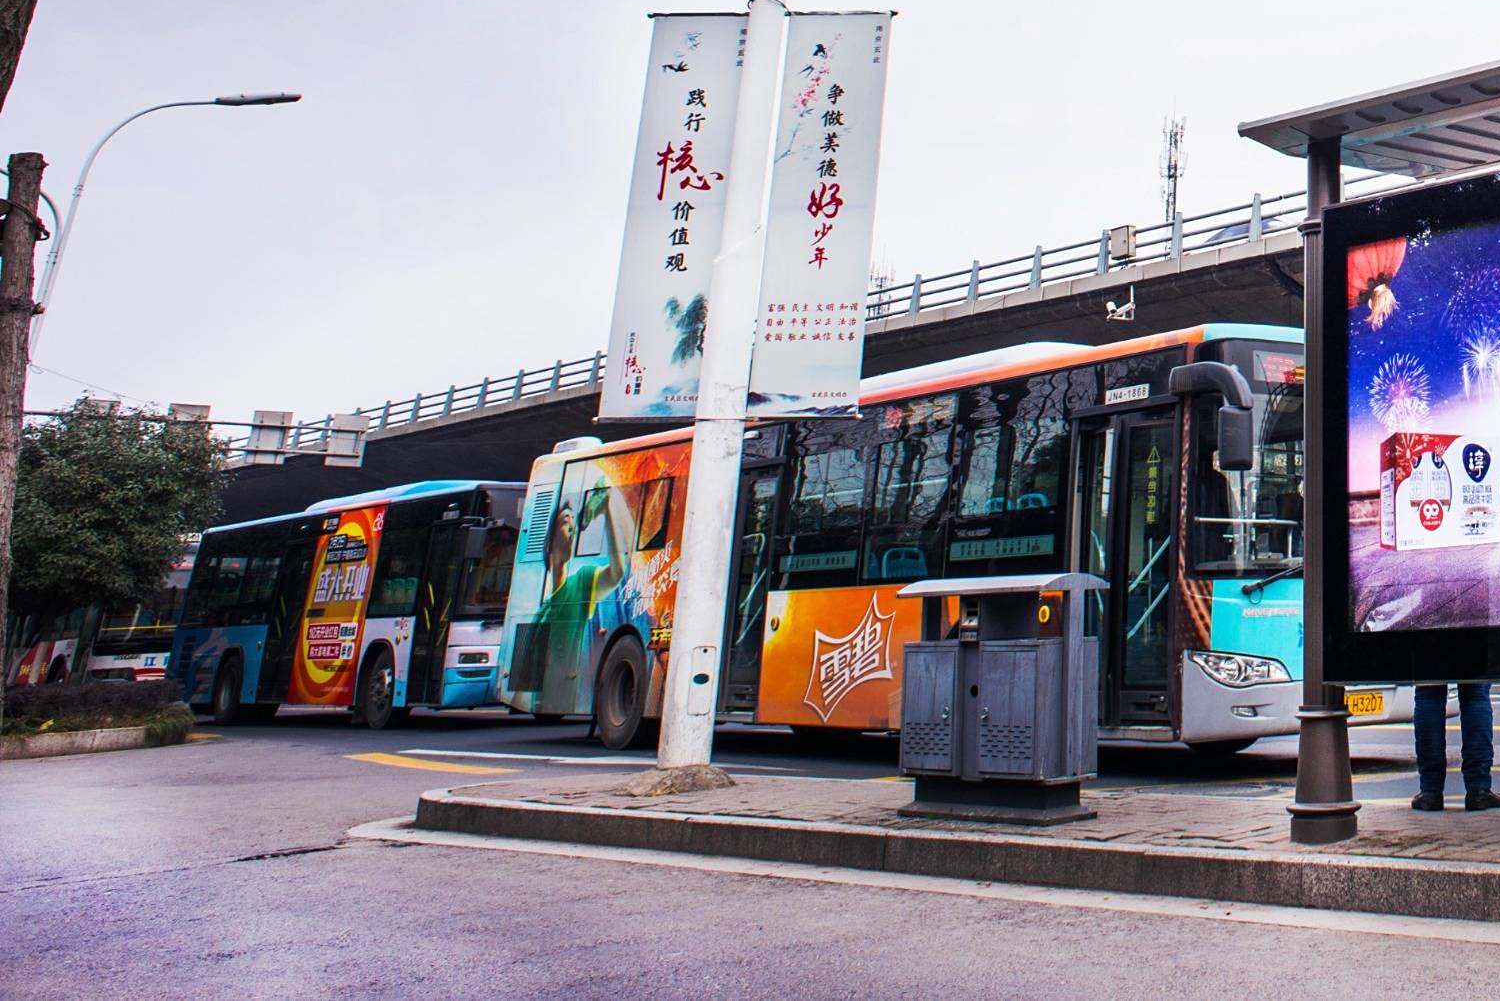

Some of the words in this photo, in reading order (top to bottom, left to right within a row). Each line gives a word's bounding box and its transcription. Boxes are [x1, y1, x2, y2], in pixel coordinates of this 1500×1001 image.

[656, 87, 725, 273] 践行核心价值观
[807, 82, 846, 270] 争做美德好少年
[314, 563, 371, 603] 盛大开业
[820, 620, 883, 705] 雪碧
